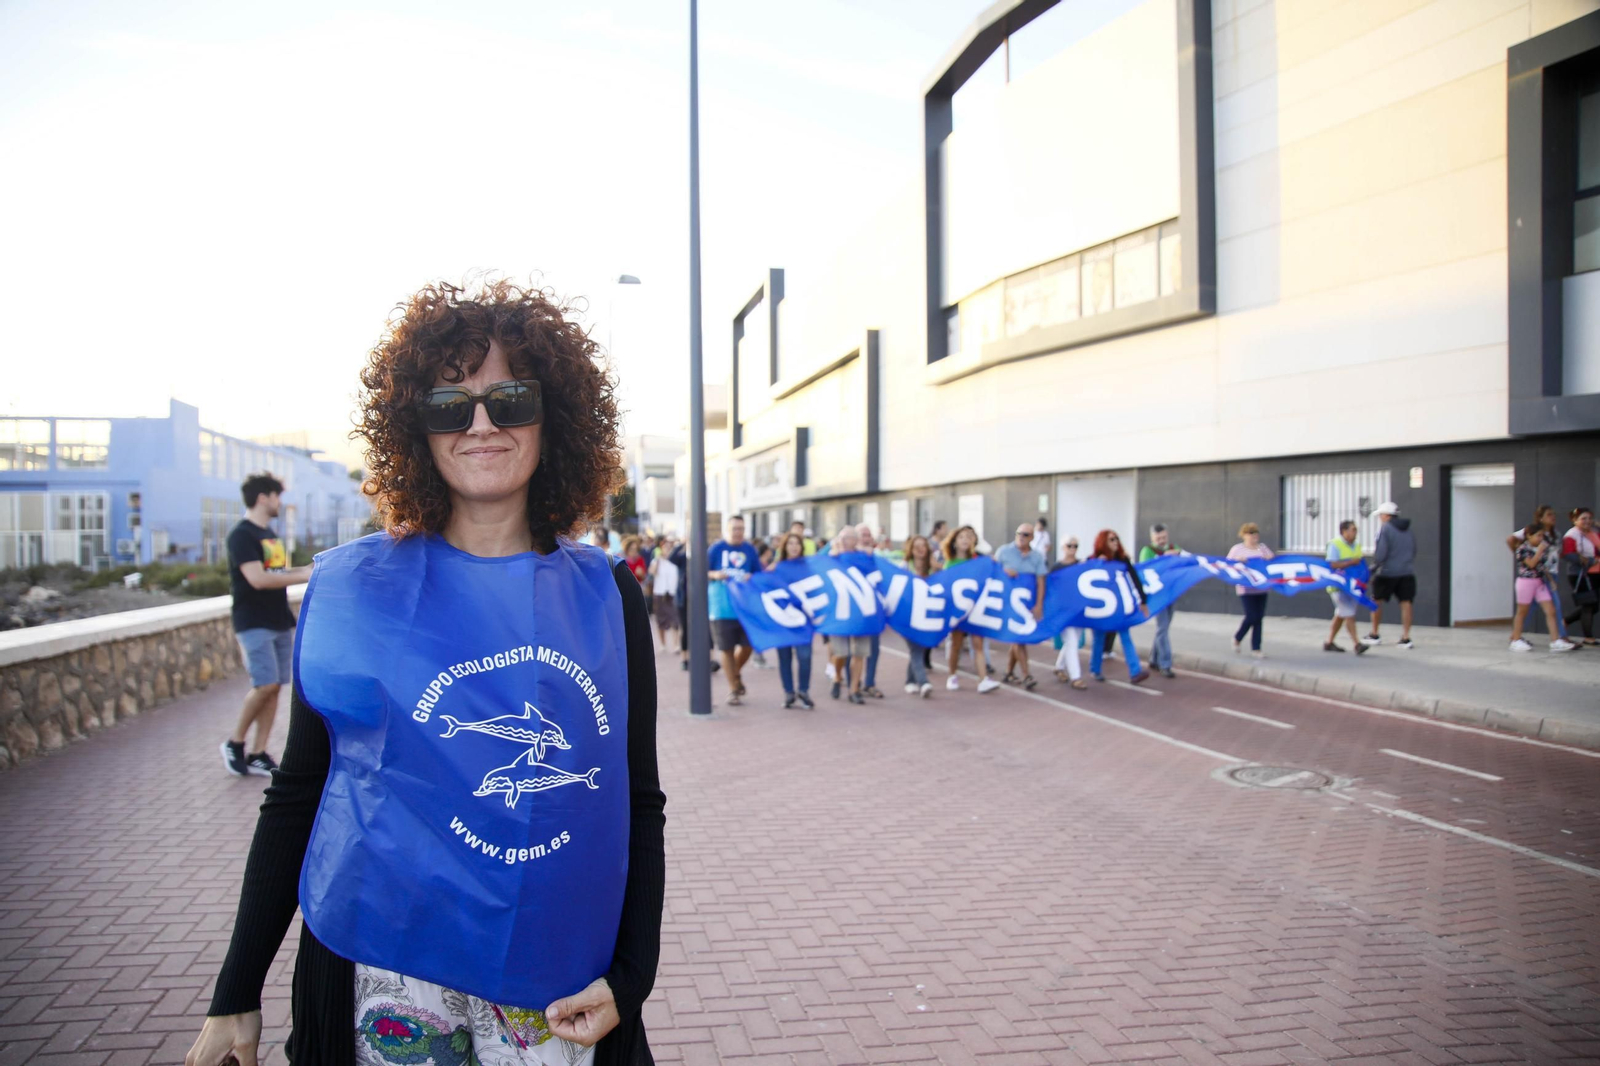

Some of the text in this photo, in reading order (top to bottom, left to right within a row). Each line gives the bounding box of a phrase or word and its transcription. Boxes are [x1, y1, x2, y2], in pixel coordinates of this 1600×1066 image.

[412, 645, 610, 736] GRUPO ECOLOGISTA MEDITERRÁNEO
[449, 815, 572, 865] www.gem.es
